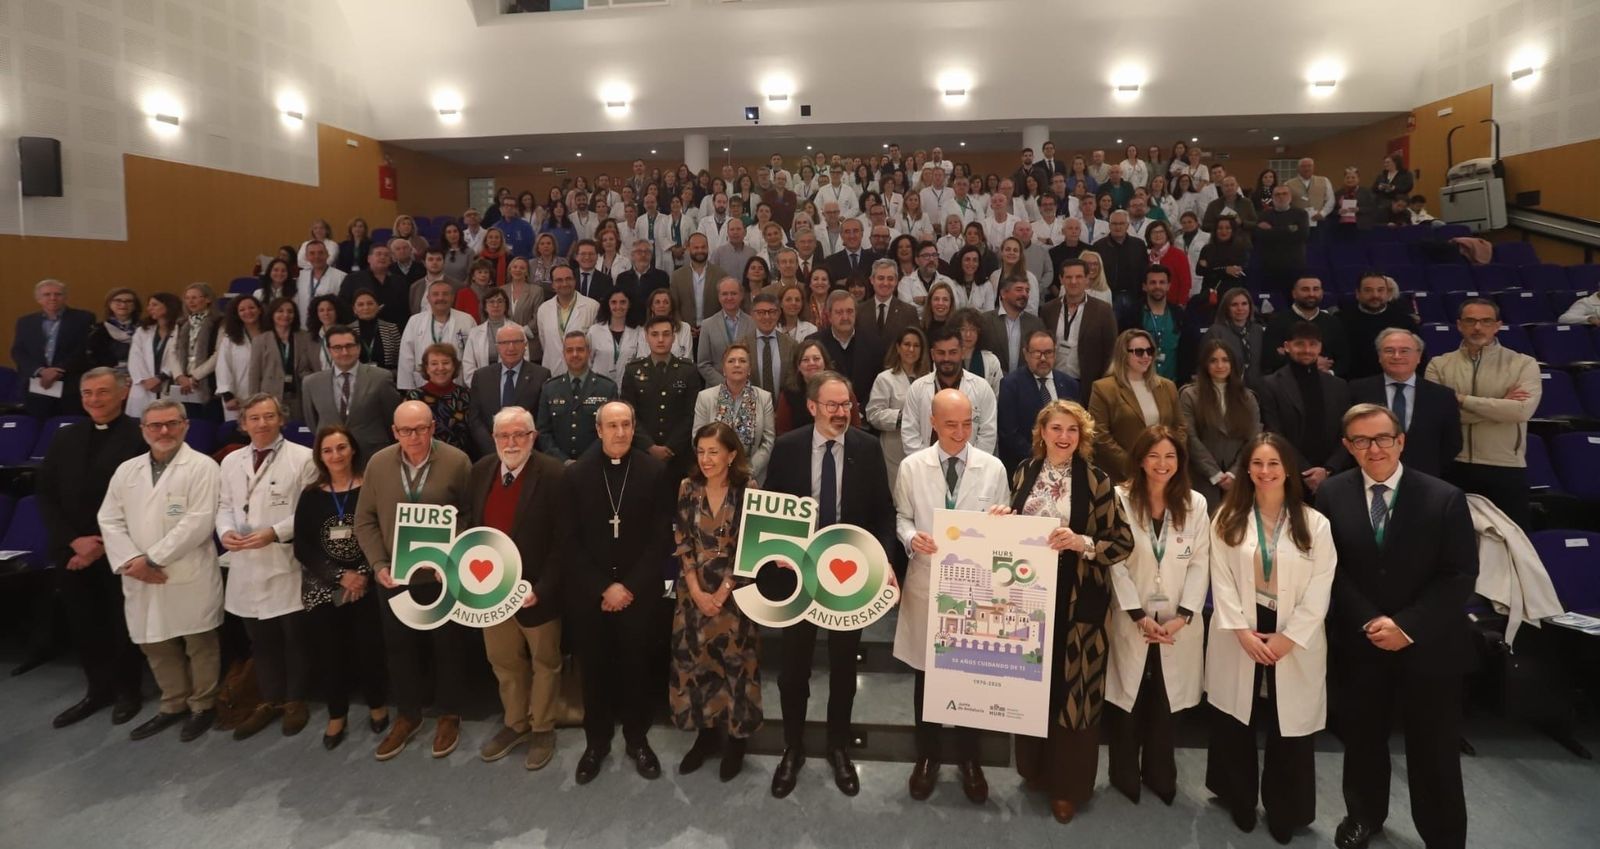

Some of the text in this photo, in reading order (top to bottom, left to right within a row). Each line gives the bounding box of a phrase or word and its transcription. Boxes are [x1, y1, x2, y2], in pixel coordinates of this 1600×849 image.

[399, 506, 453, 525] HURS
[746, 493, 812, 519] HURS
[736, 513, 886, 624] 50
[992, 549, 1013, 557] HURS
[390, 525, 519, 626] 50
[992, 556, 1036, 587] 50
[452, 583, 528, 624] ANIVERSARIO
[807, 588, 894, 627] ANIVERSARIO
[977, 660, 1009, 669] CUIDANDO
